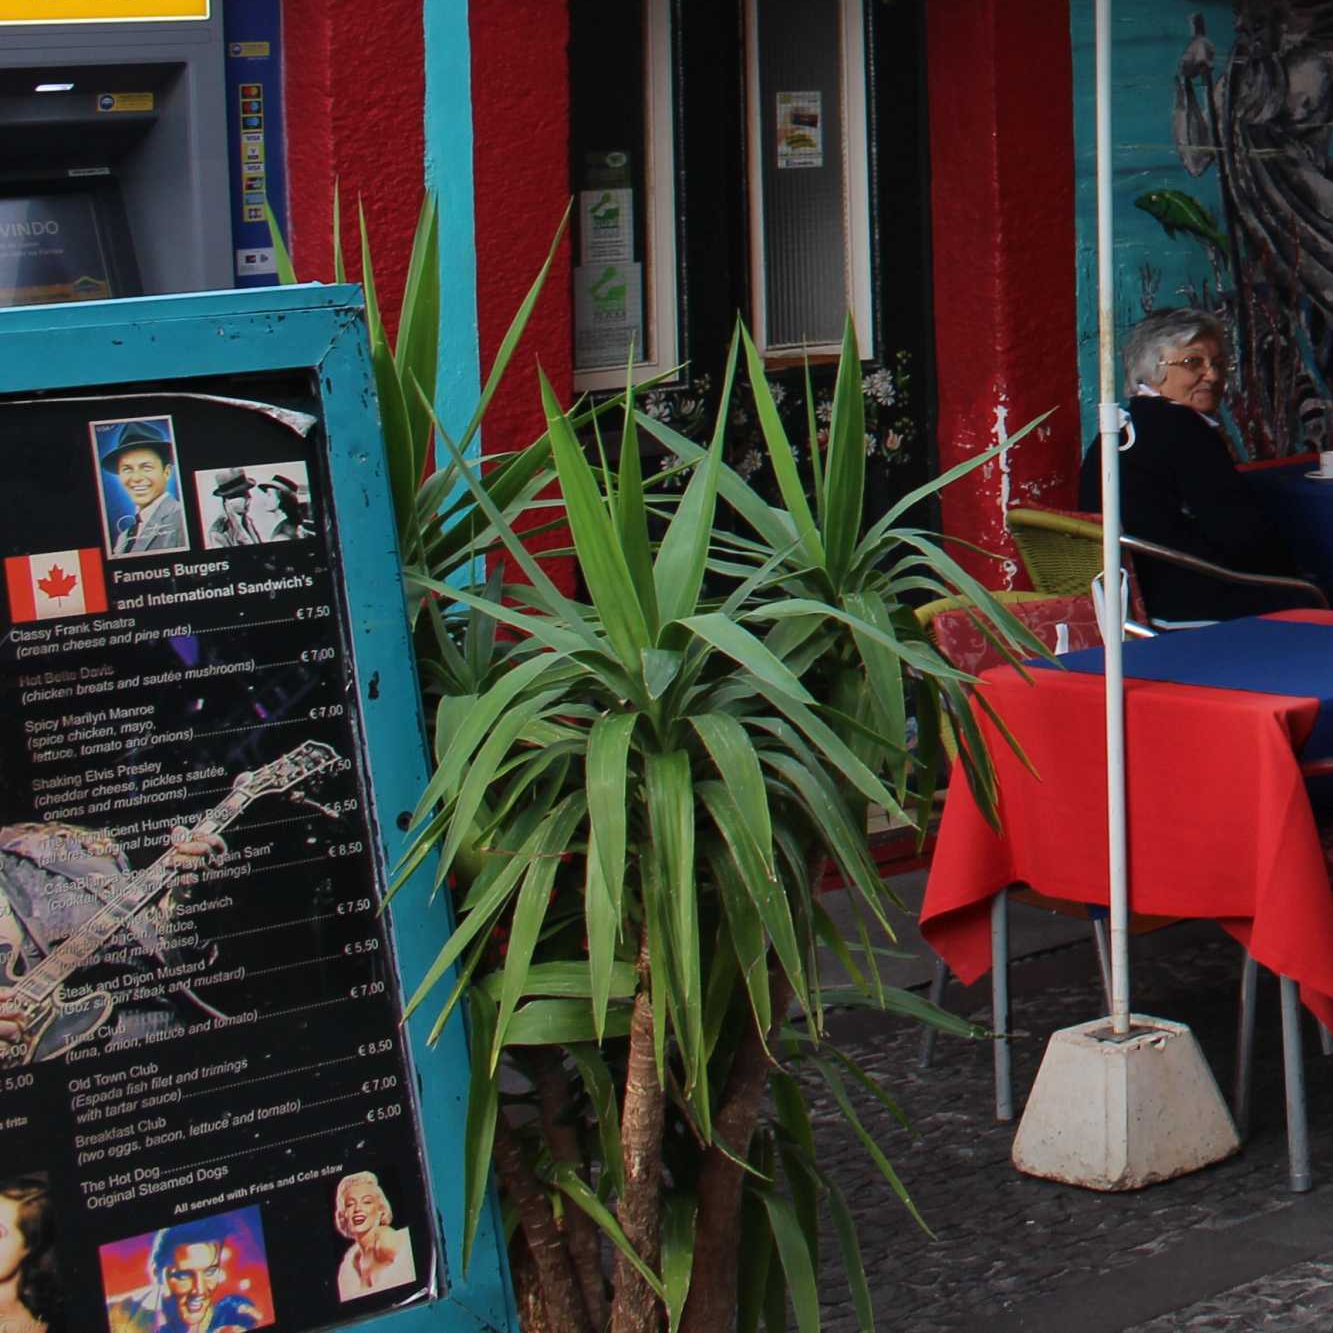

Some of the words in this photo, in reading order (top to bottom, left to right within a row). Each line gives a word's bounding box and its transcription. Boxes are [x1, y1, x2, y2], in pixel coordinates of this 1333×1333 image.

[114, 567, 171, 584] Famous
[174, 560, 230, 577] Burgers
[117, 595, 144, 611] and
[147, 584, 235, 606] International
[237, 574, 314, 596] Sandwich's
[9, 627, 52, 644] Classy
[55, 623, 90, 636] Frank
[92, 617, 136, 632] Sinatra
[16, 642, 59, 660] (cream
[62, 636, 107, 652] cheese
[109, 631, 132, 646] and
[134, 628, 160, 645] pine
[163, 623, 192, 639] nuts)
[21, 688, 73, 706] (chicken
[76, 681, 114, 696] breats
[117, 676, 140, 689] and
[143, 670, 182, 686] sautée
[185, 660, 256, 680] mushrooms)
[24, 719, 60, 734] Spicy
[62, 711, 107, 728] Marilyn
[109, 704, 155, 720] Manroe
[27, 733, 65, 750] (spice
[67, 726, 117, 743] chicken,
[120, 719, 157, 735] mayo,
[32, 749, 77, 764] lettuce,
[80, 741, 122, 756] tomato
[125, 735, 148, 749] and
[151, 727, 194, 745] onions)
[32, 774, 82, 792] Shaking
[85, 769, 114, 783] Elvis
[117, 761, 161, 779] Presley
[34, 791, 88, 809] (cheddar
[91, 781, 138, 797] cheese,
[142, 772, 183, 791] pickles
[43, 805, 85, 821] onions
[88, 798, 111, 813] and
[114, 786, 188, 809] mushrooms)
[141, 813, 201, 832] Humphrey
[202, 864, 252, 883] trimings)
[208, 850, 241, 867] Again
[176, 896, 233, 916] Sandwich
[104, 948, 127, 963] and
[97, 977, 120, 993] and
[122, 970, 155, 988] Dijon
[157, 959, 206, 978] Mustard
[132, 983, 165, 1001] steak
[168, 977, 191, 993] and
[194, 966, 246, 988] mustard)
[65, 1046, 101, 1064] (tuna,
[104, 1037, 142, 1054] onion,
[145, 1025, 186, 1044] lettuce
[188, 1021, 211, 1037] and
[214, 1009, 258, 1029] tomato)
[98, 1024, 127, 1040] Club
[68, 1077, 91, 1094] Old
[94, 1070, 127, 1087] Town
[129, 1063, 158, 1080] Club
[70, 1088, 123, 1111] (Espada
[126, 1082, 148, 1097] fish
[151, 1074, 173, 1090] filet
[175, 1068, 199, 1084] and
[201, 1059, 248, 1079] trimings
[76, 1109, 102, 1124] with
[105, 1100, 138, 1118] tartar
[141, 1088, 182, 1109] sauce)
[75, 1124, 135, 1148] Breakfast
[138, 1116, 167, 1133] Club
[77, 1147, 105, 1166] (two
[108, 1141, 142, 1158] eggs,
[145, 1130, 186, 1148] bacon,
[189, 1118, 229, 1137] lettuce
[232, 1110, 254, 1127] and
[257, 1098, 301, 1120] tomato)
[80, 1179, 106, 1195] The
[108, 1172, 132, 1188] Hot
[134, 1166, 161, 1182] Dog
[86, 1185, 136, 1209] Original
[138, 1172, 194, 1197] Steamed
[196, 1165, 229, 1182] Dogs
[174, 1201, 189, 1215] All
[190, 1194, 224, 1211] served
[226, 1188, 248, 1202] with
[249, 1179, 275, 1196] Fries
[276, 1175, 295, 1189] and
[296, 1170, 319, 1183] Cole
[321, 1163, 343, 1177] slaw
